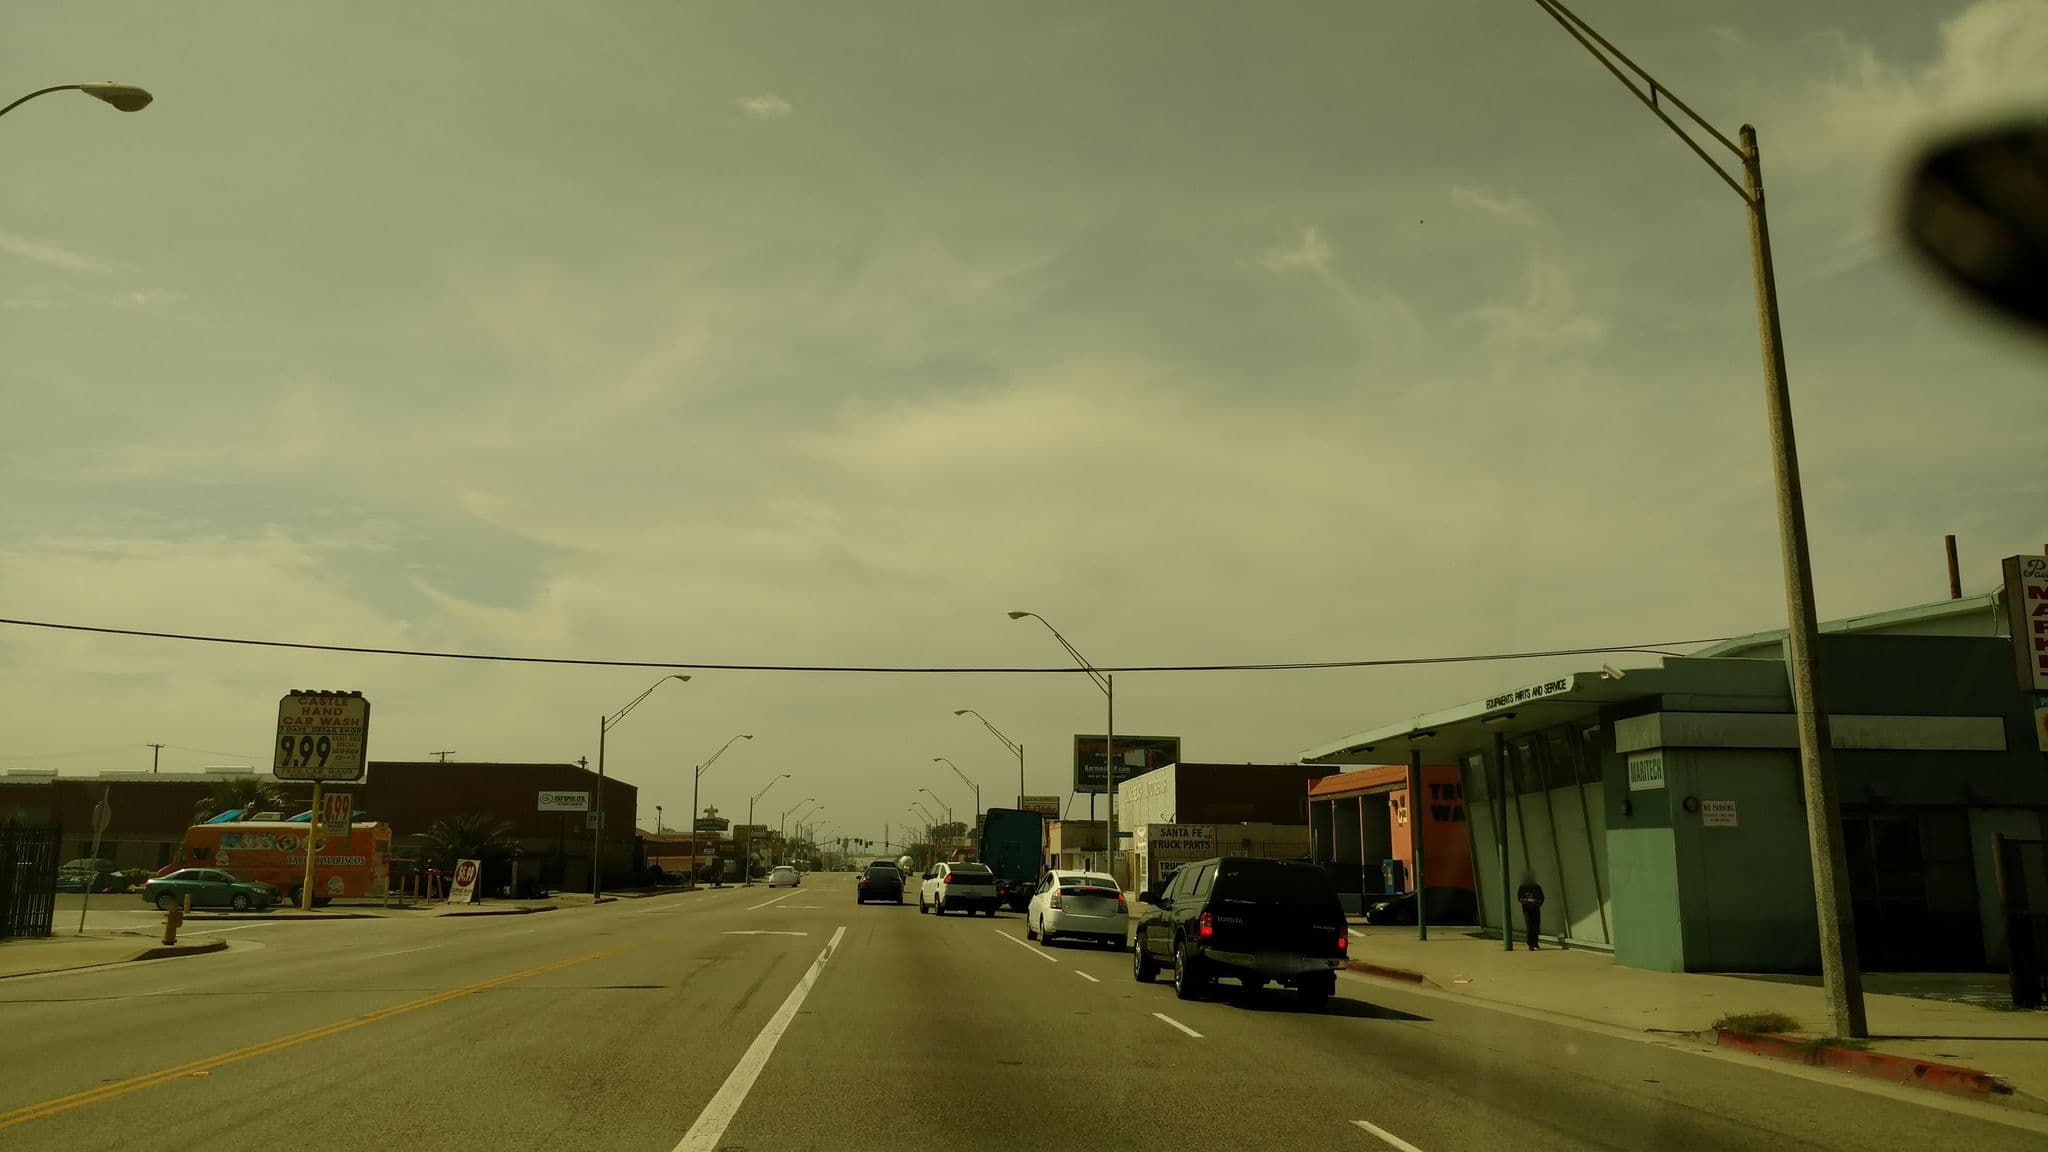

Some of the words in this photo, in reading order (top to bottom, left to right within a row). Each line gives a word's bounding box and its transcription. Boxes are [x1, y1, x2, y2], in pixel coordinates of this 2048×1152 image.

[1515, 688, 1531, 702] PARTS
[1532, 685, 1543, 697] AND
[1544, 678, 1566, 695] SERVICE
[298, 698, 350, 706] CASTLE
[302, 707, 343, 716] HAND
[283, 716, 313, 726] CAR
[320, 717, 360, 727] WASH
[281, 735, 331, 767] 9.99
[1630, 758, 1662, 783] MARITECH
[1430, 784, 1464, 801] TRU
[1431, 806, 1466, 822] WA
[1160, 828, 1189, 838] SANTA
[1192, 828, 1203, 838] FE
[1153, 839, 1181, 849] TRUCK
[1183, 839, 1211, 850] PARTS
[320, 856, 367, 866] MARISCOS
